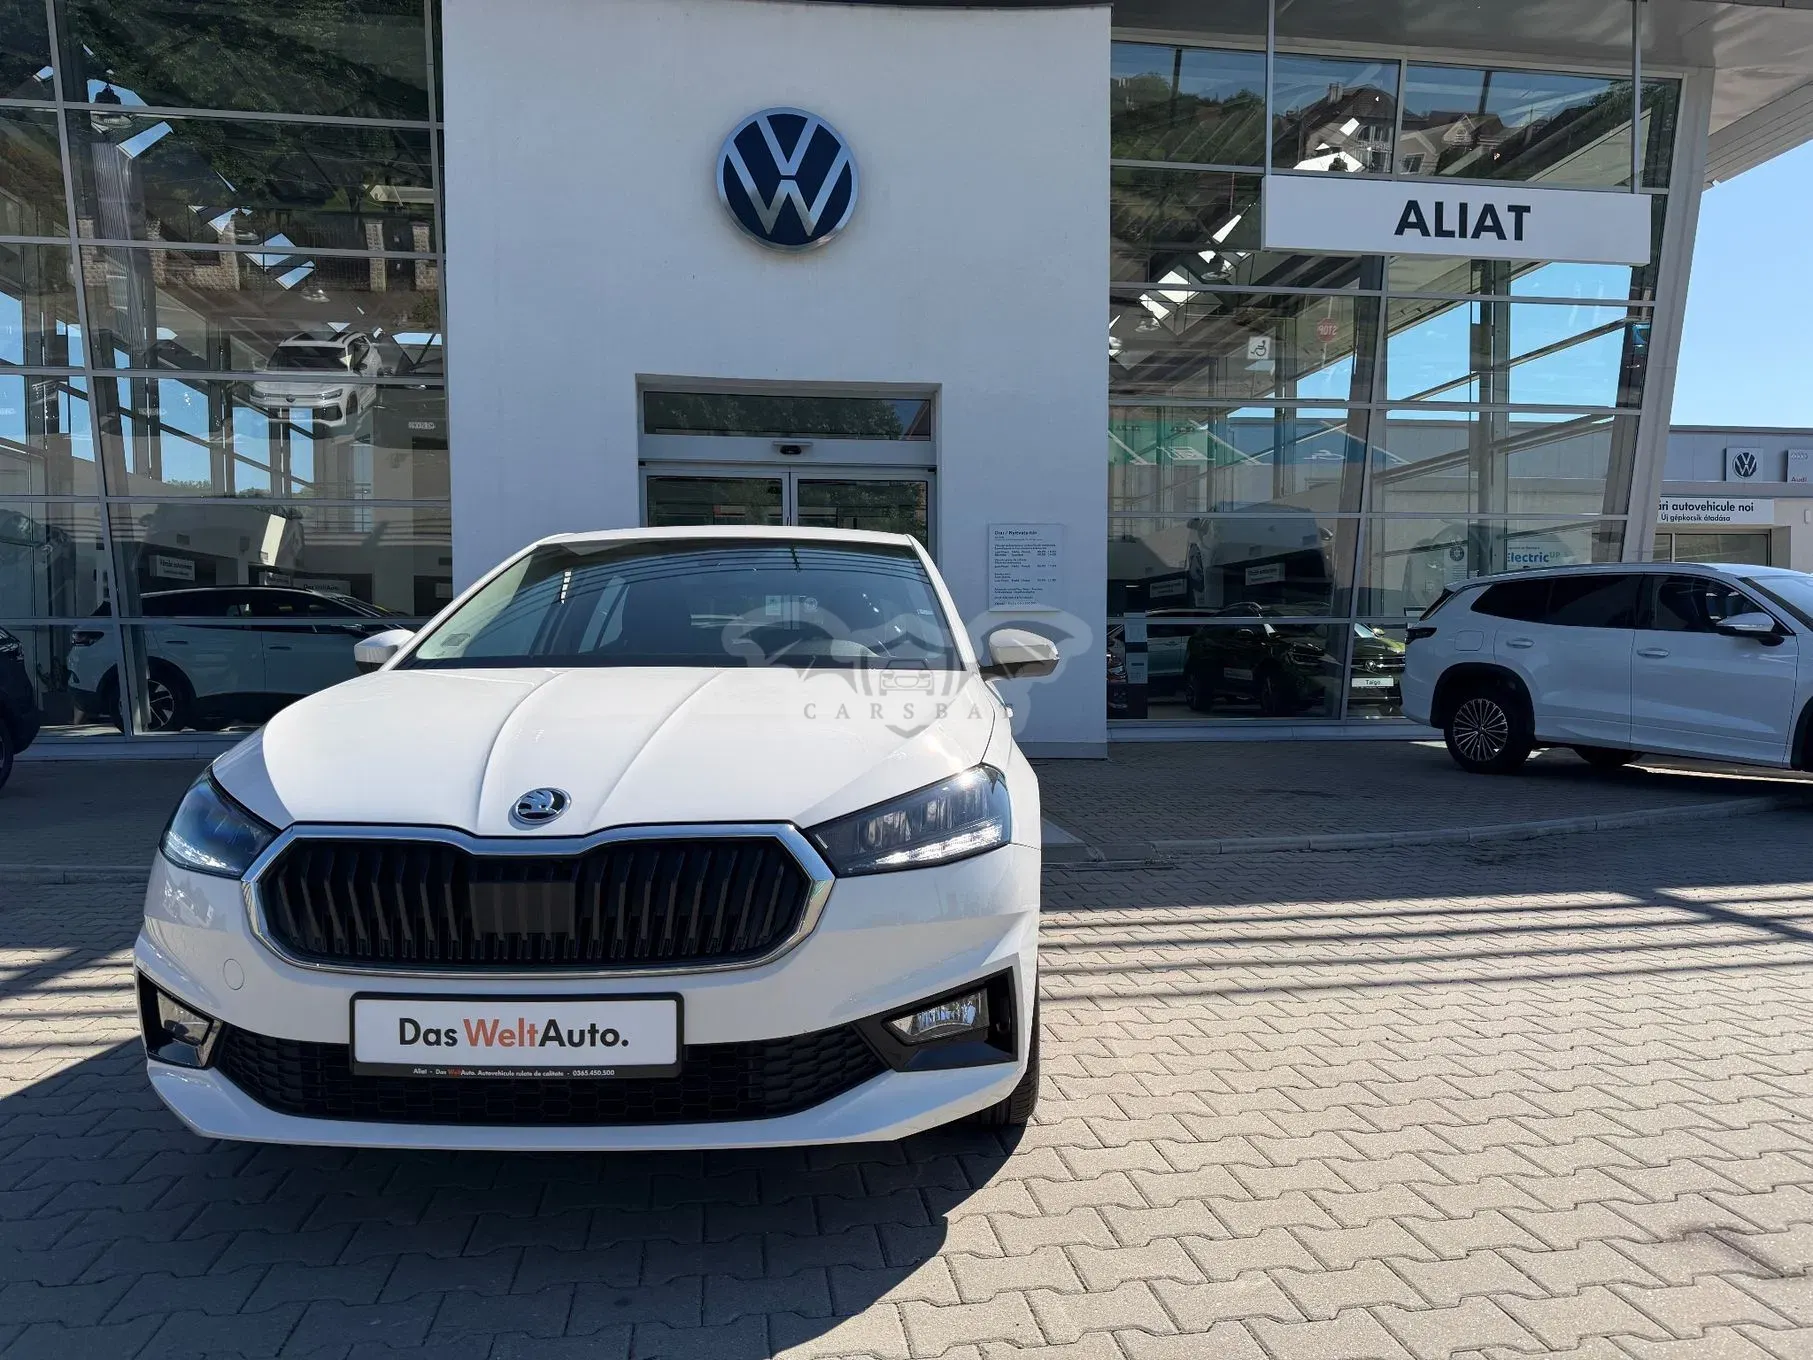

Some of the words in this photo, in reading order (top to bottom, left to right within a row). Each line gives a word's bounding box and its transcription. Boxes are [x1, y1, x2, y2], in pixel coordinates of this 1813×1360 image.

[1393, 200, 1531, 241] ALIAT
[1671, 500, 1736, 512] autovehicule
[1738, 502, 1754, 512] noi
[1669, 513, 1703, 522] gépkocsik
[399, 1017, 458, 1047] Das
[463, 1017, 630, 1048] WeltAuto.
